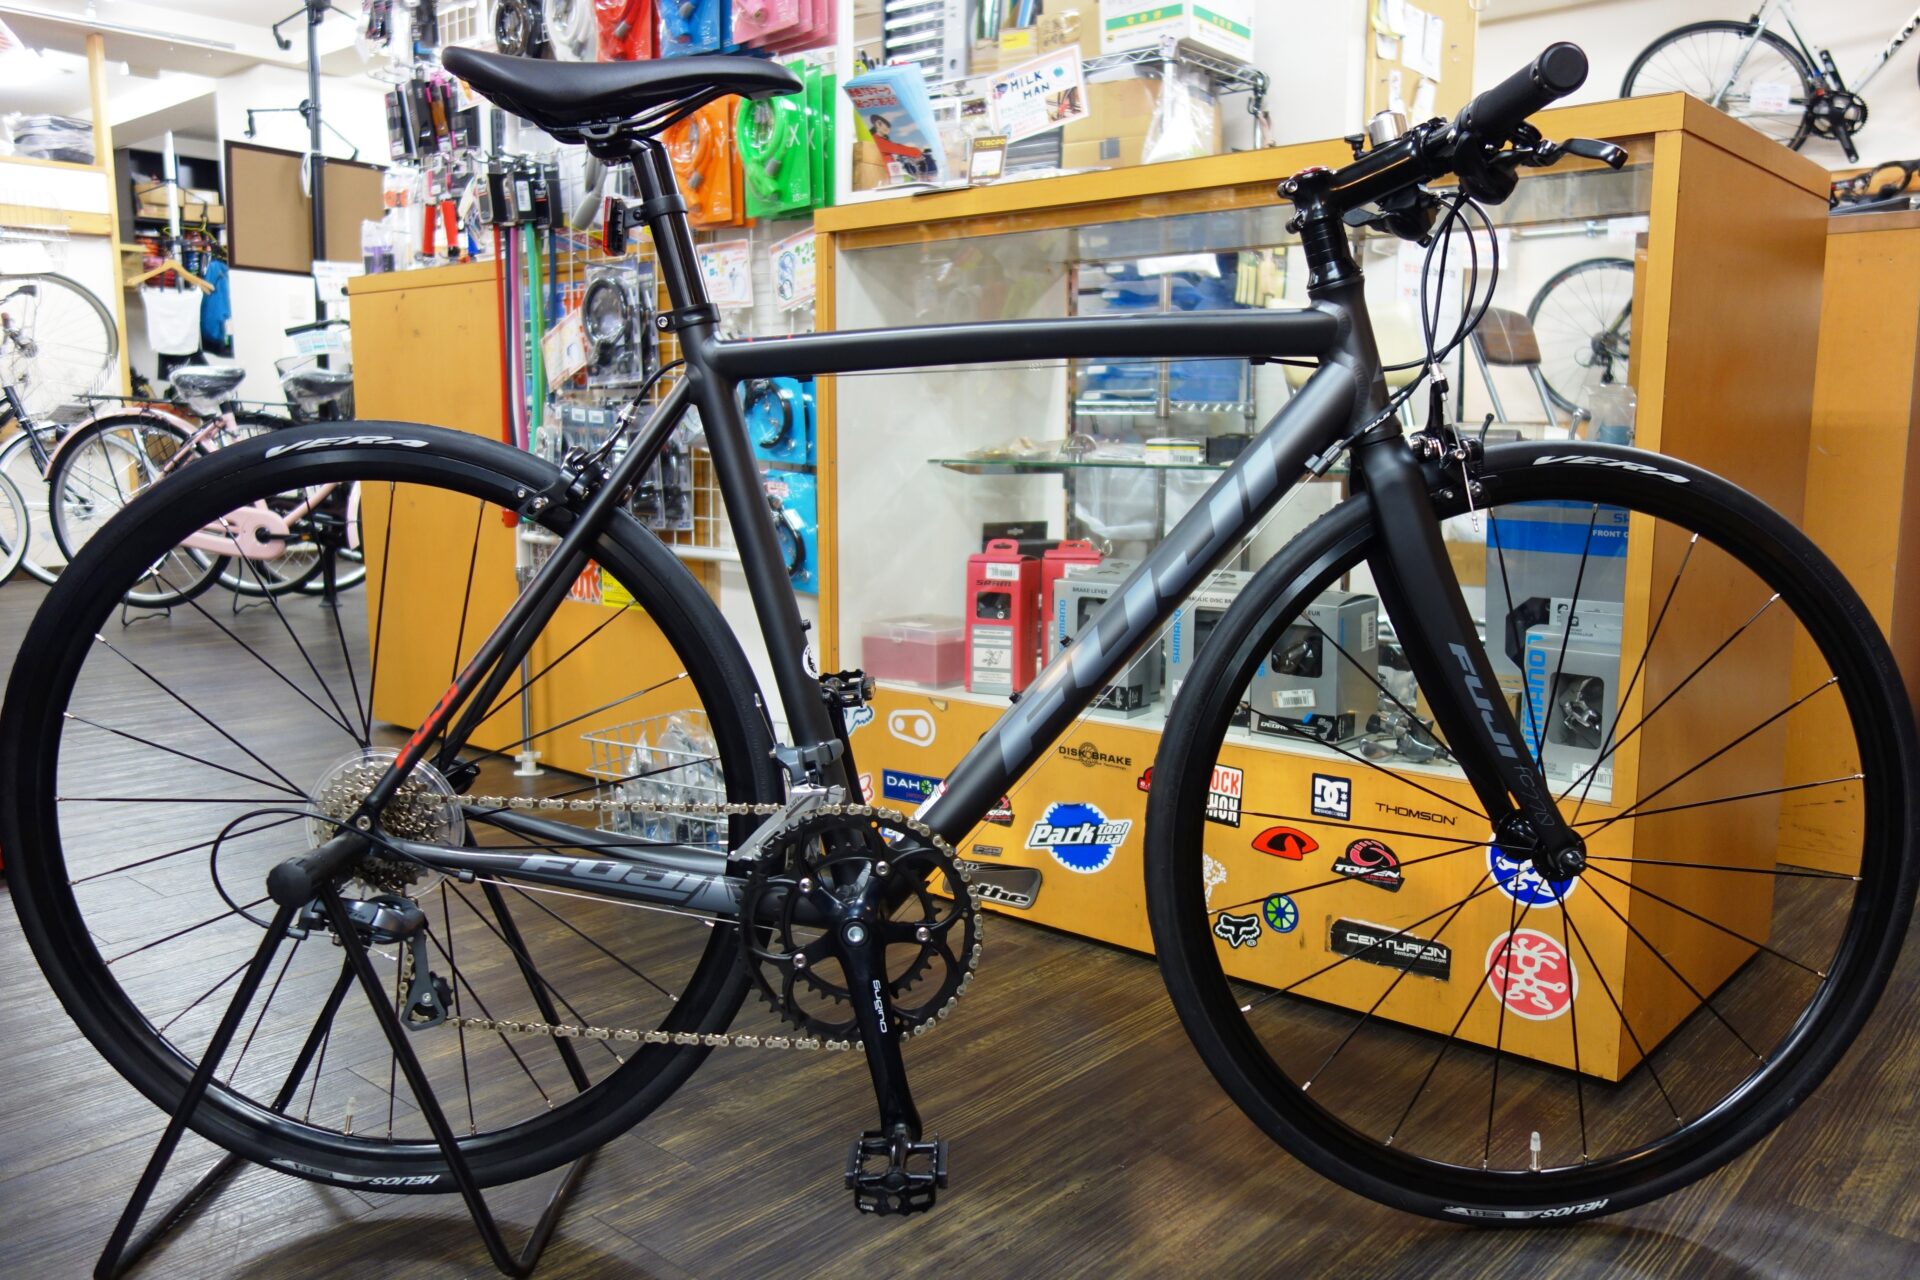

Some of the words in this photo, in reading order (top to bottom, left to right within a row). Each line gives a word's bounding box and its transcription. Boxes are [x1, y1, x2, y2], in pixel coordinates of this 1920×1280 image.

[1010, 71, 1043, 93] MILK
[1023, 83, 1050, 100] MAN
[265, 434, 430, 459] VERA
[1533, 455, 1691, 483] VERA
[1592, 529, 1620, 538] FRONT
[1000, 437, 1279, 774] FUJI
[1448, 642, 1518, 759] FUJI
[1091, 752, 1132, 766] BRAKE
[1375, 802, 1456, 825] THOMSON
[1029, 822, 1096, 847] Park
[1097, 821, 1130, 835] Tool
[369, 1174, 440, 1186] HELIOS
[1540, 1198, 1609, 1218] HELIOS
